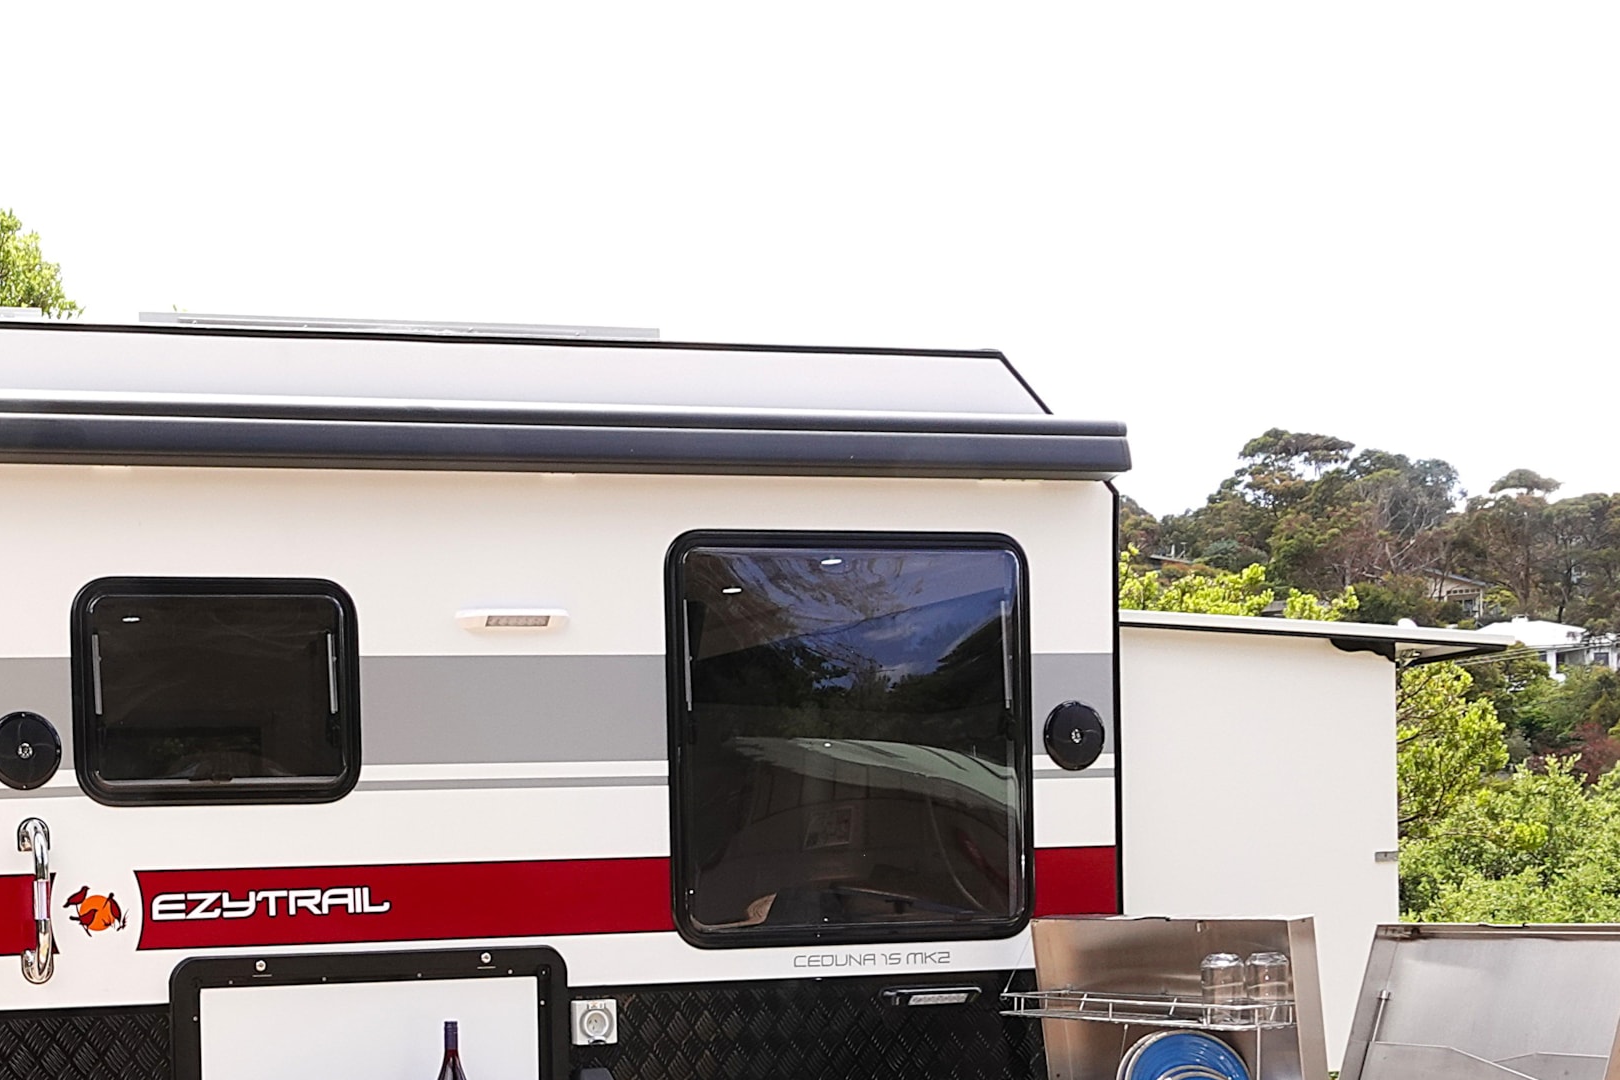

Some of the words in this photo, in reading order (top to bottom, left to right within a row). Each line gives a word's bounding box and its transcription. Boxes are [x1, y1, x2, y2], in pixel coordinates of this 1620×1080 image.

[151, 886, 391, 921] EZYTRAIL
[793, 953, 876, 968] CEDUNA
[906, 951, 951, 966] MK2
